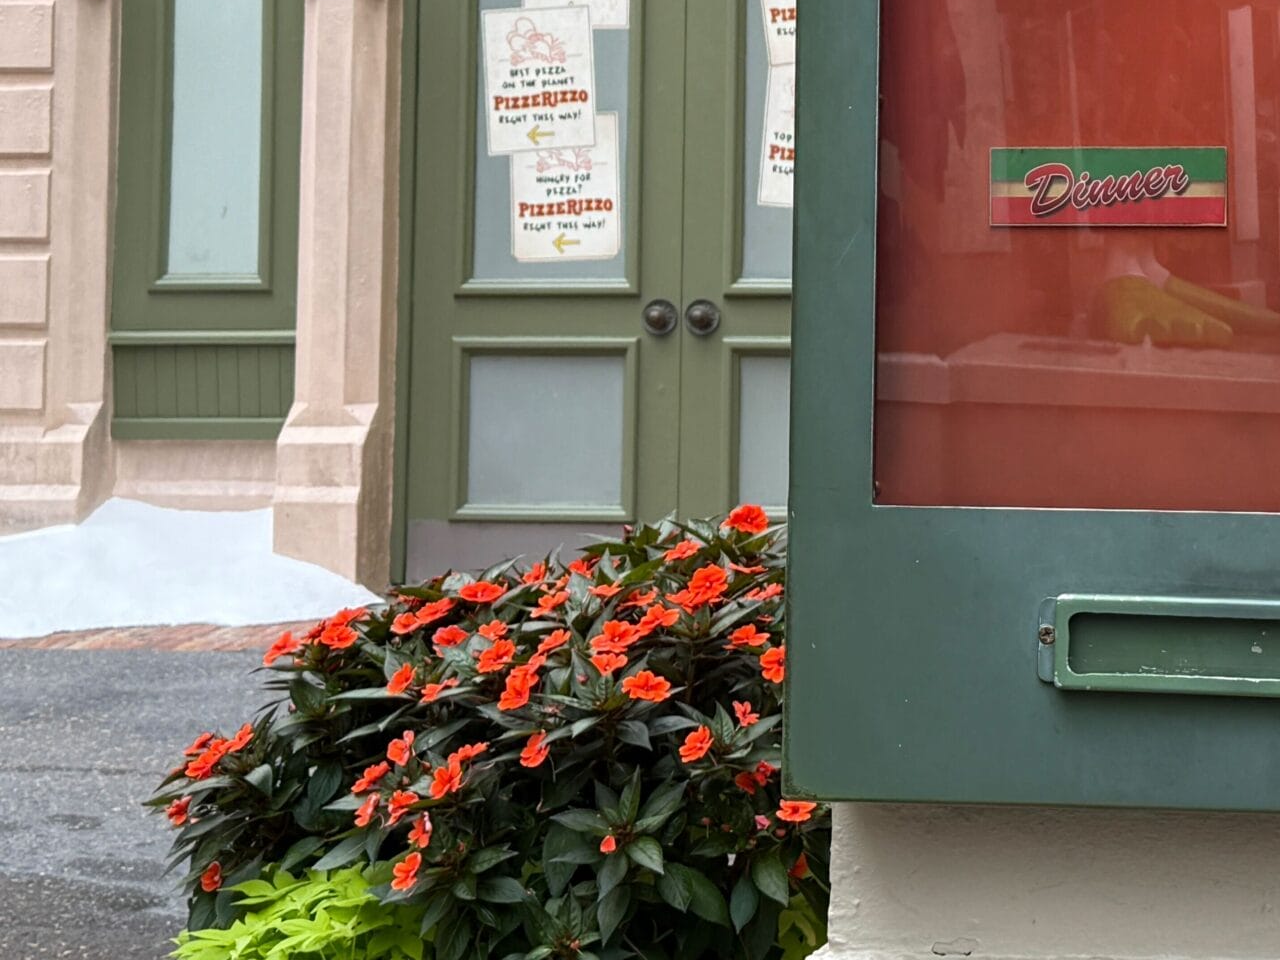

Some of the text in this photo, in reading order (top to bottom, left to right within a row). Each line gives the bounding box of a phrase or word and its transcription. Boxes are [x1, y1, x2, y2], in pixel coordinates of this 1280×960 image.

[510, 66, 566, 77] BEST PIZZA
[502, 76, 574, 89] ON THE PLANET
[493, 89, 588, 111] PIZZERIZZO
[498, 108, 582, 125] RIGHT THIS WAY!
[773, 131, 793, 143] TOP
[536, 172, 591, 184] HUNGRY FOR
[546, 183, 583, 197] PIZZA?
[1024, 162, 1189, 216] Dinner
[518, 198, 613, 217] PIZZERIZZO
[523, 218, 606, 232] RIGHT THIS WAY!
